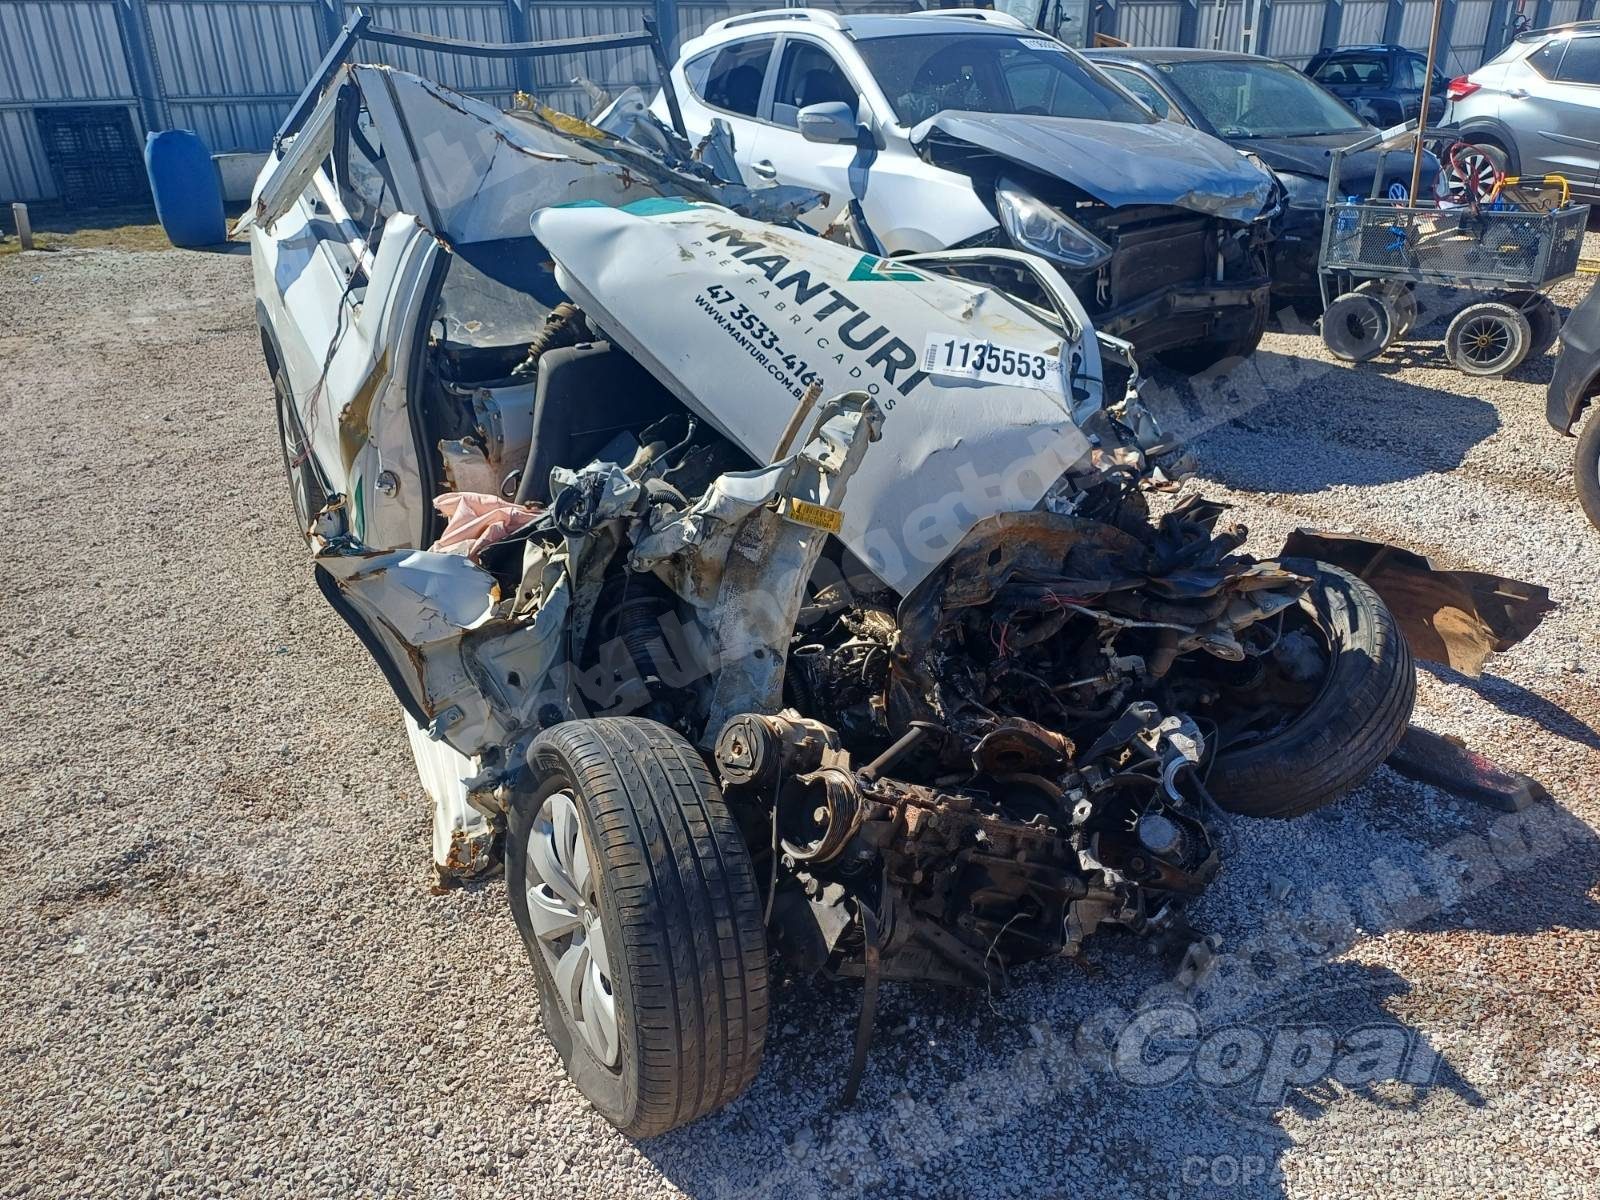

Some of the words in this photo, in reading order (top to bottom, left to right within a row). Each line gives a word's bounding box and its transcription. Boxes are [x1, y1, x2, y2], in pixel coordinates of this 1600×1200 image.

[691, 240, 896, 411] PRÉ-FABRICADOS
[706, 229, 930, 397] MANTURI
[706, 284, 735, 304] 47
[730, 303, 824, 388] 3533-416
[944, 339, 1046, 381] 1135553
